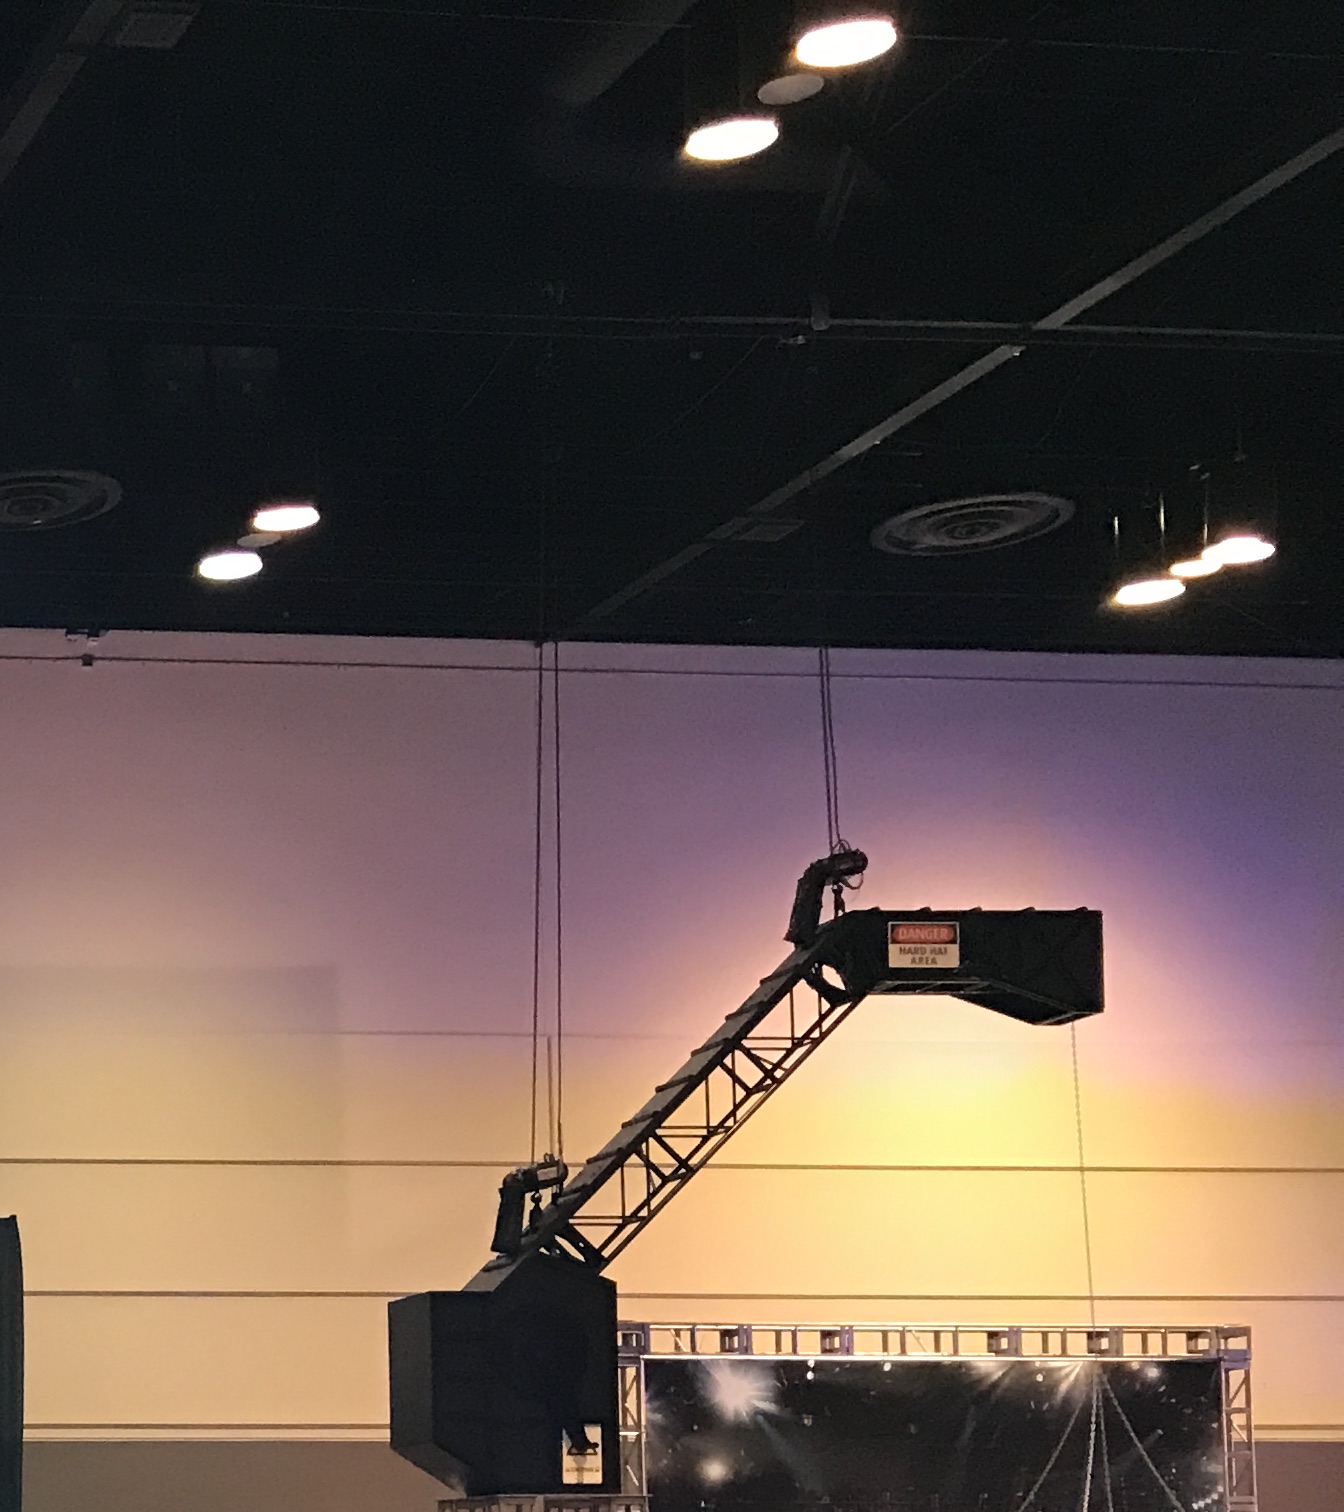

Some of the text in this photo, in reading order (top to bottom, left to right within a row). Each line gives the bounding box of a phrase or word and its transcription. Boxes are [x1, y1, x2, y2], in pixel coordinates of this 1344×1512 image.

[898, 926, 949, 940] DANGER
[899, 946, 948, 955] HARD HAT
[910, 956, 938, 965] AREA
